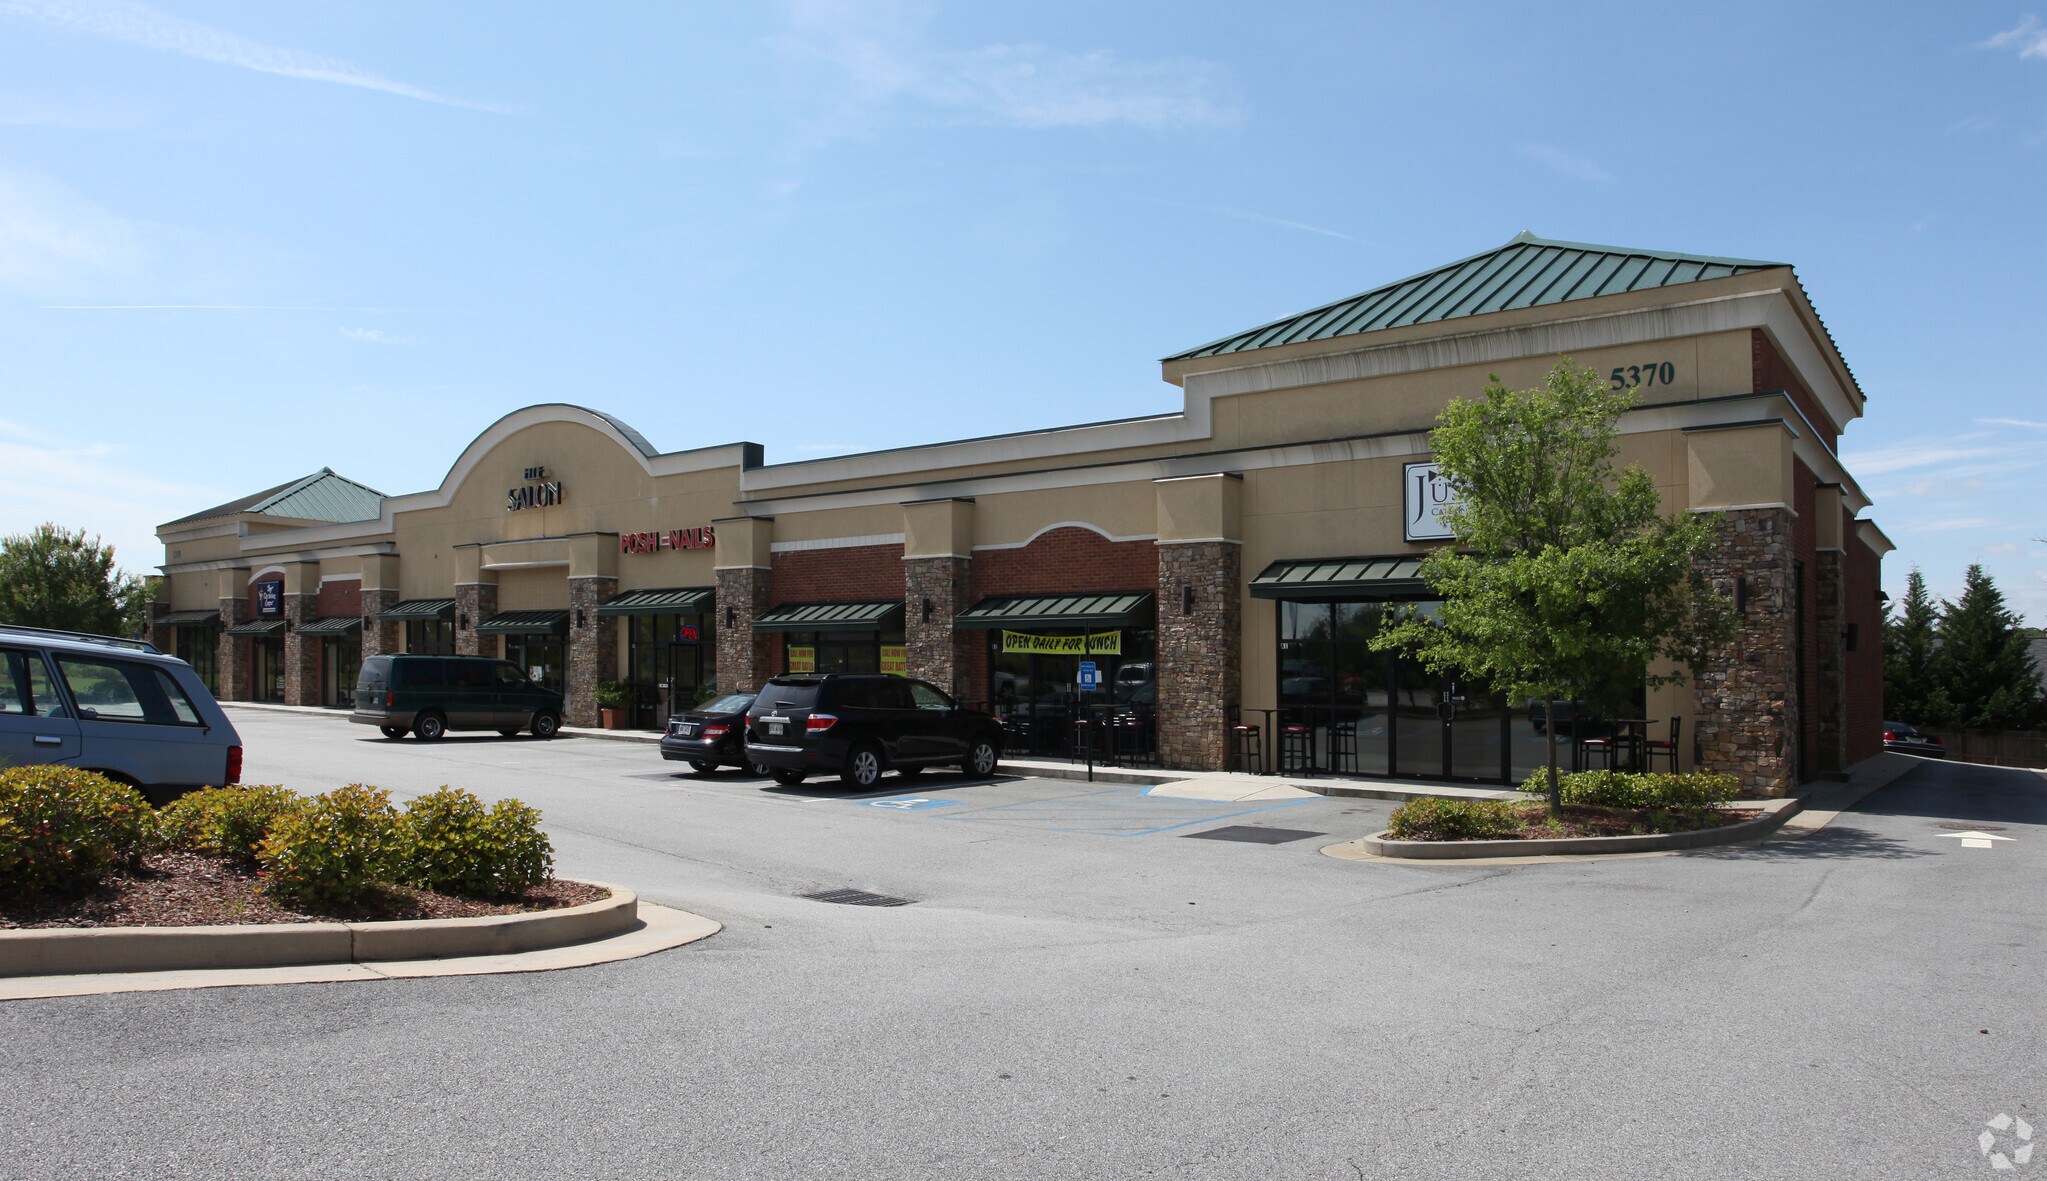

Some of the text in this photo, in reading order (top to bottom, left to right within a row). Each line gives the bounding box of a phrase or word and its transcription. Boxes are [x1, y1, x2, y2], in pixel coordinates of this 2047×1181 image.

[1610, 361, 1675, 391] 5370
[507, 481, 562, 511] SALON
[681, 626, 699, 641] OPEN
[1006, 635, 1031, 649] OPEN
[1033, 637, 1061, 650] DAILY
[1062, 637, 1083, 651] FOR
